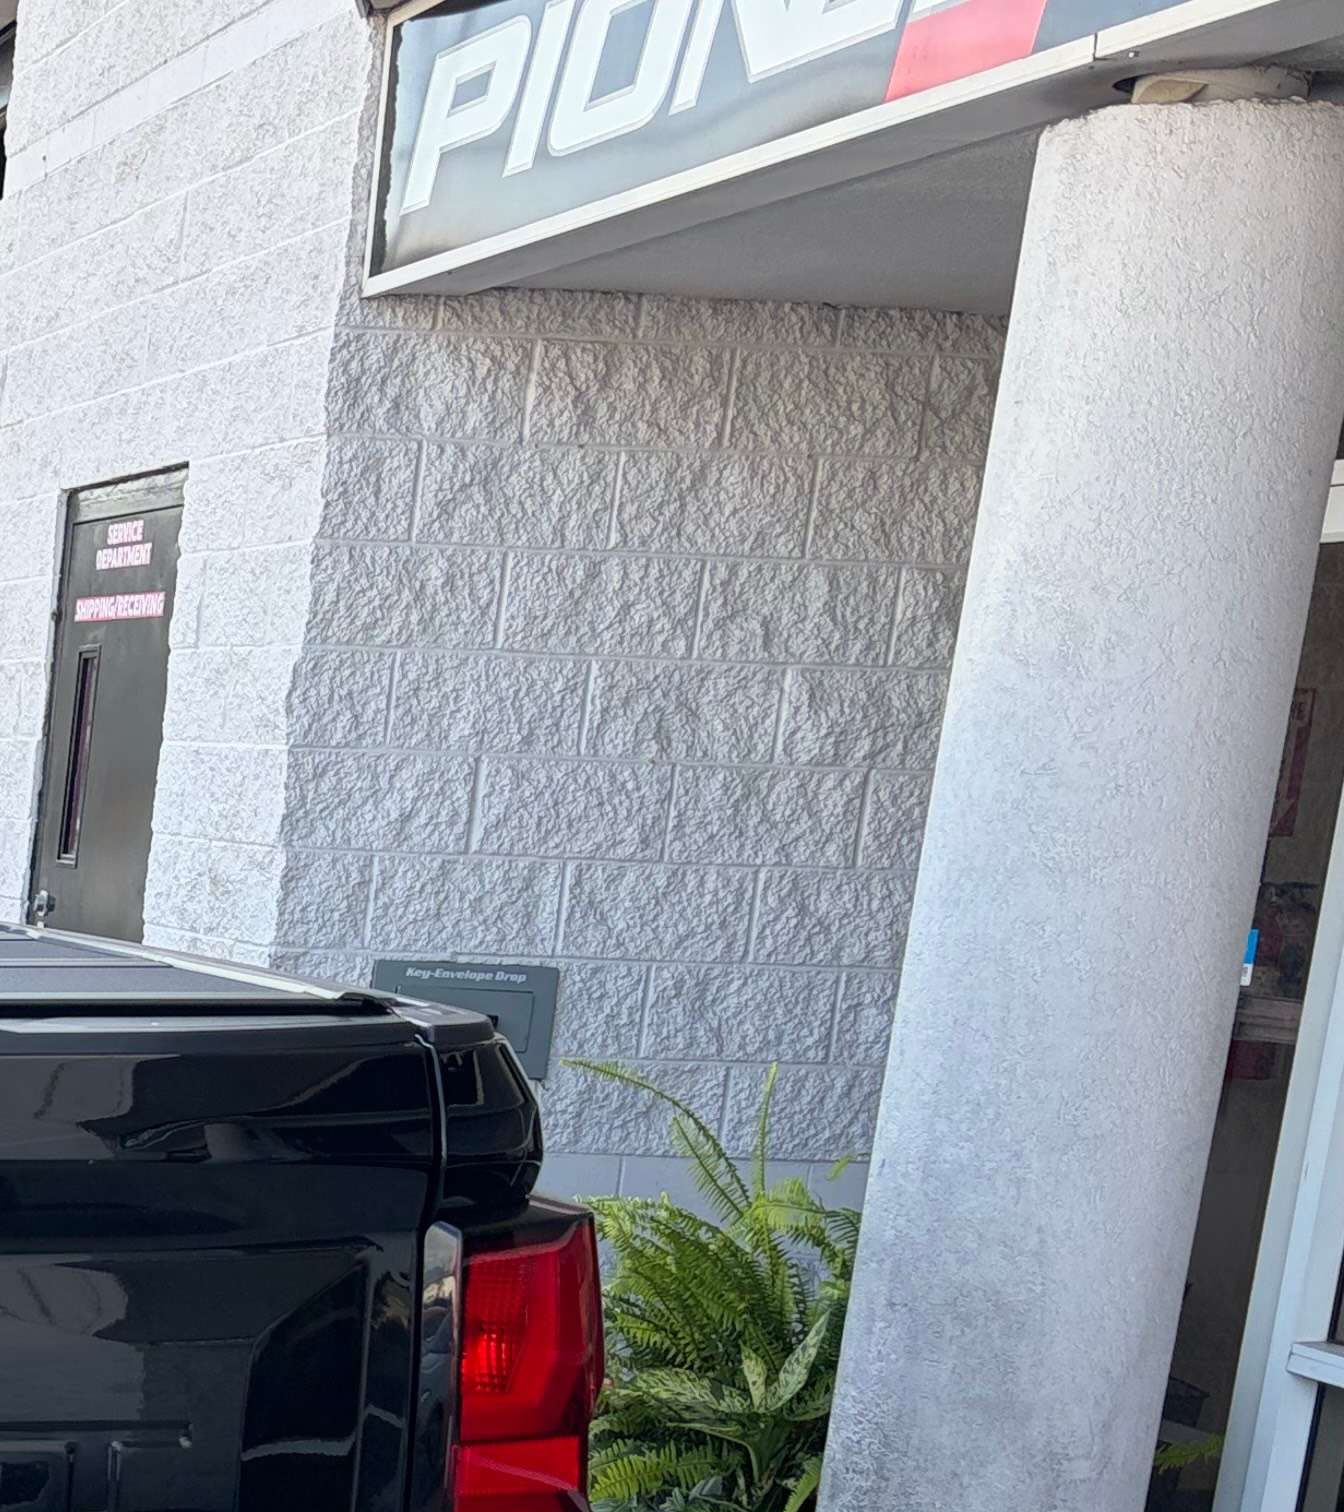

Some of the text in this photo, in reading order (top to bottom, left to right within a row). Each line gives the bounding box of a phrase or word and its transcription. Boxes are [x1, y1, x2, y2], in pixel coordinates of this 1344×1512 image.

[106, 519, 144, 545] SERVICE
[95, 542, 152, 571] DEPARTMENT
[75, 592, 165, 620] SHIPPING/RECEIVING
[405, 967, 527, 984] Key-Envelope Drop
